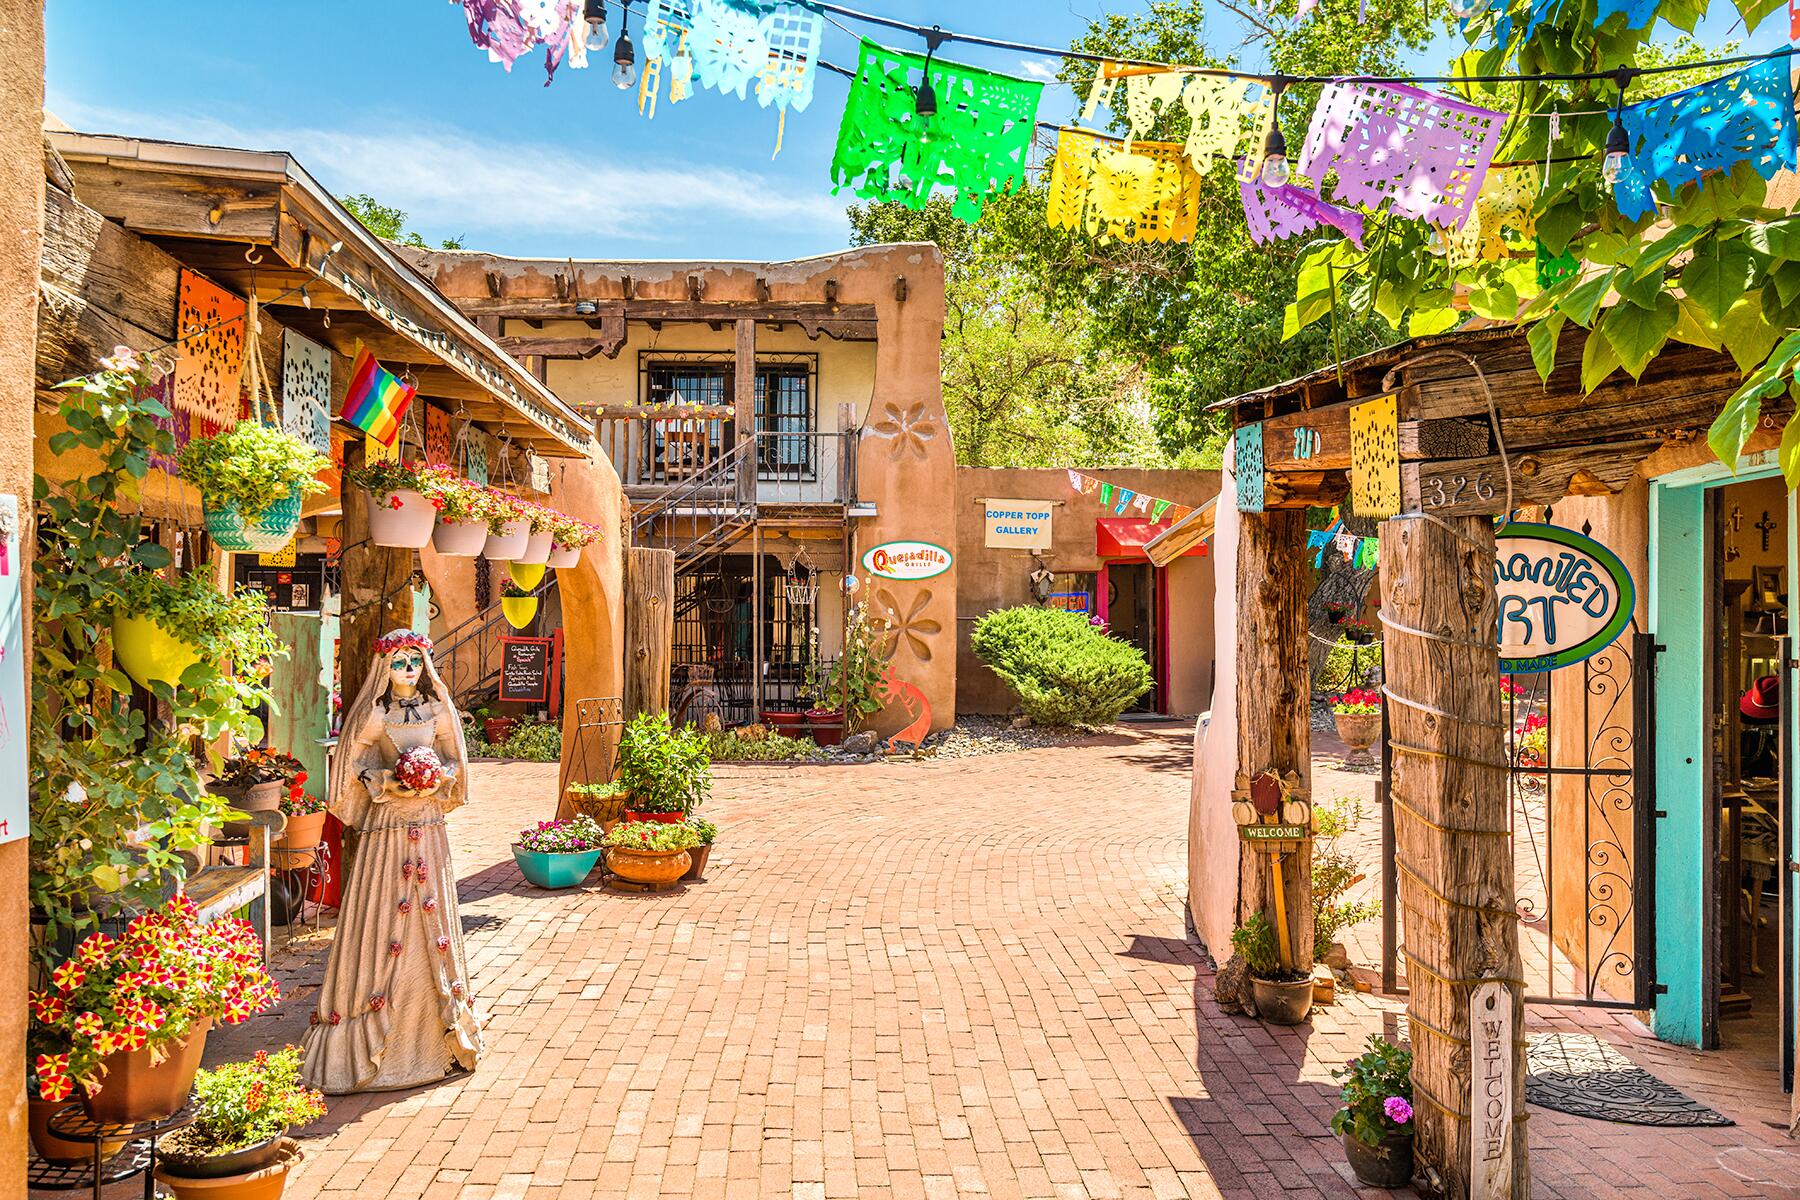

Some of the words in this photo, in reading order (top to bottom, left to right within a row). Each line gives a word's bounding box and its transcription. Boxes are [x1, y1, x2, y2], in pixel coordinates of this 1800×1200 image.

[1429, 473, 1495, 507] 326
[986, 510, 1023, 519] COPPER
[1026, 512, 1050, 520] TOPP
[995, 526, 1039, 535] GALLERY
[872, 549, 946, 574] Quesadilla
[1050, 595, 1087, 610] OPEN
[1517, 655, 1558, 671] MADE
[1247, 827, 1300, 838] WELCOME
[1481, 1020, 1503, 1162] WELCOME
